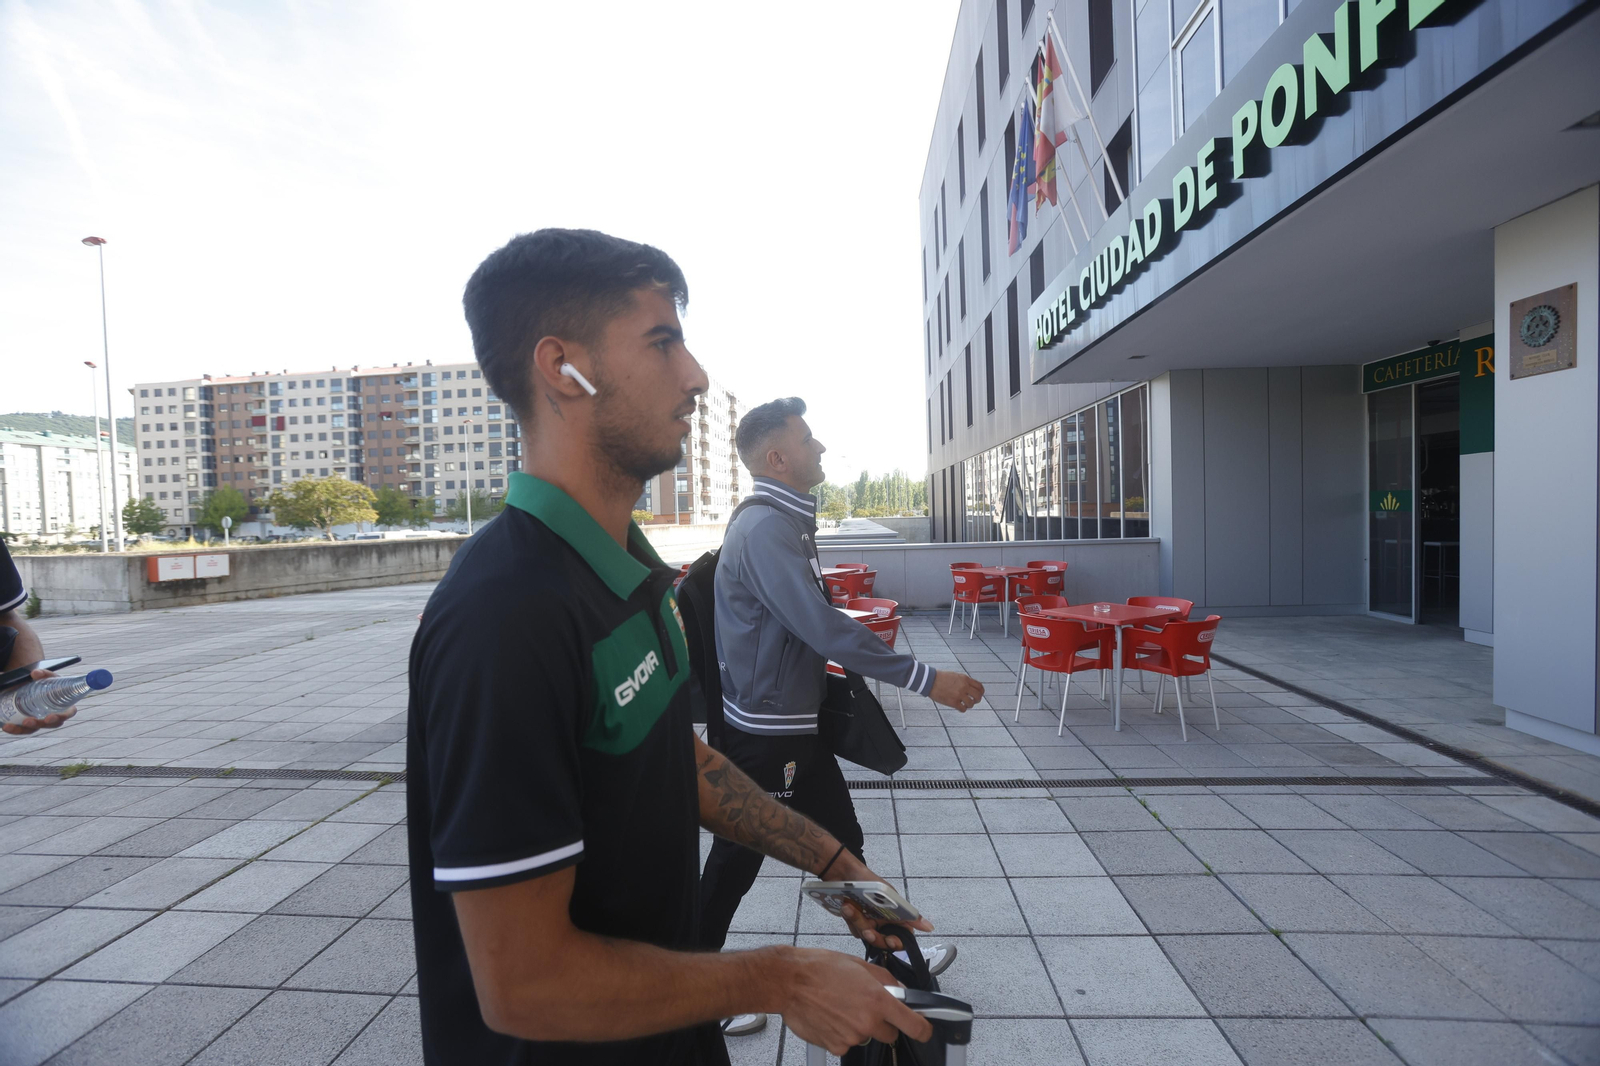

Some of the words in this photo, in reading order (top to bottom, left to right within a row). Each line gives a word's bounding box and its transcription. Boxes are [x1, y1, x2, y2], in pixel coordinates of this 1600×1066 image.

[1035, 286, 1076, 350] HOTEL
[1079, 198, 1162, 311] CIUDAD
[1173, 137, 1218, 233] DE
[1232, 0, 1446, 180] PONF
